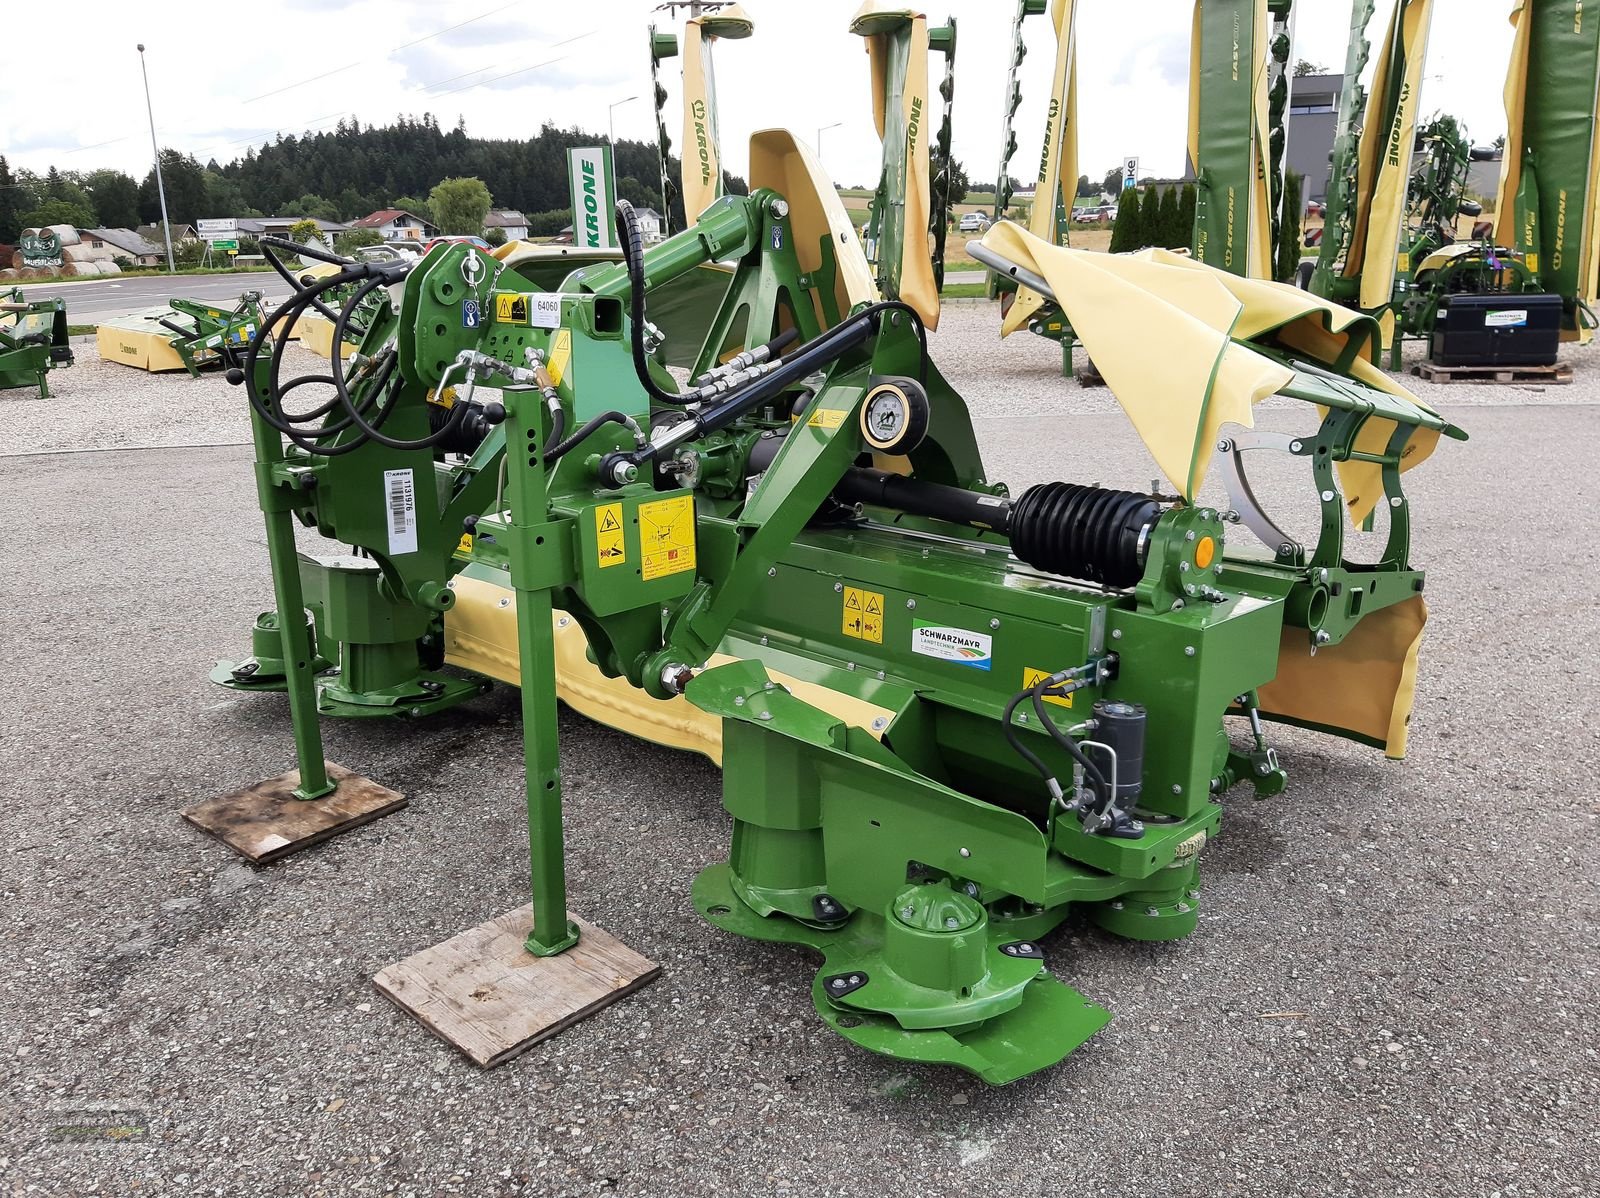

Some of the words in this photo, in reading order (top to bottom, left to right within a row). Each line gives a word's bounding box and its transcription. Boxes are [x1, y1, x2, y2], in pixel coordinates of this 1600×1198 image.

[1574, 0, 1582, 34] EAS
[695, 121, 710, 186] KRONE
[908, 96, 922, 156] RONE
[1038, 119, 1053, 184] KRONE
[1388, 104, 1404, 167] KRONE
[581, 159, 600, 248] KRONE
[1227, 186, 1235, 248] KRONE
[1555, 189, 1567, 251] KRONE
[537, 300, 559, 312] 64060
[404, 480, 413, 512] 1131976
[919, 628, 981, 649] SCHWARZMAYR
[920, 638, 956, 650] LANDTECHNIK
